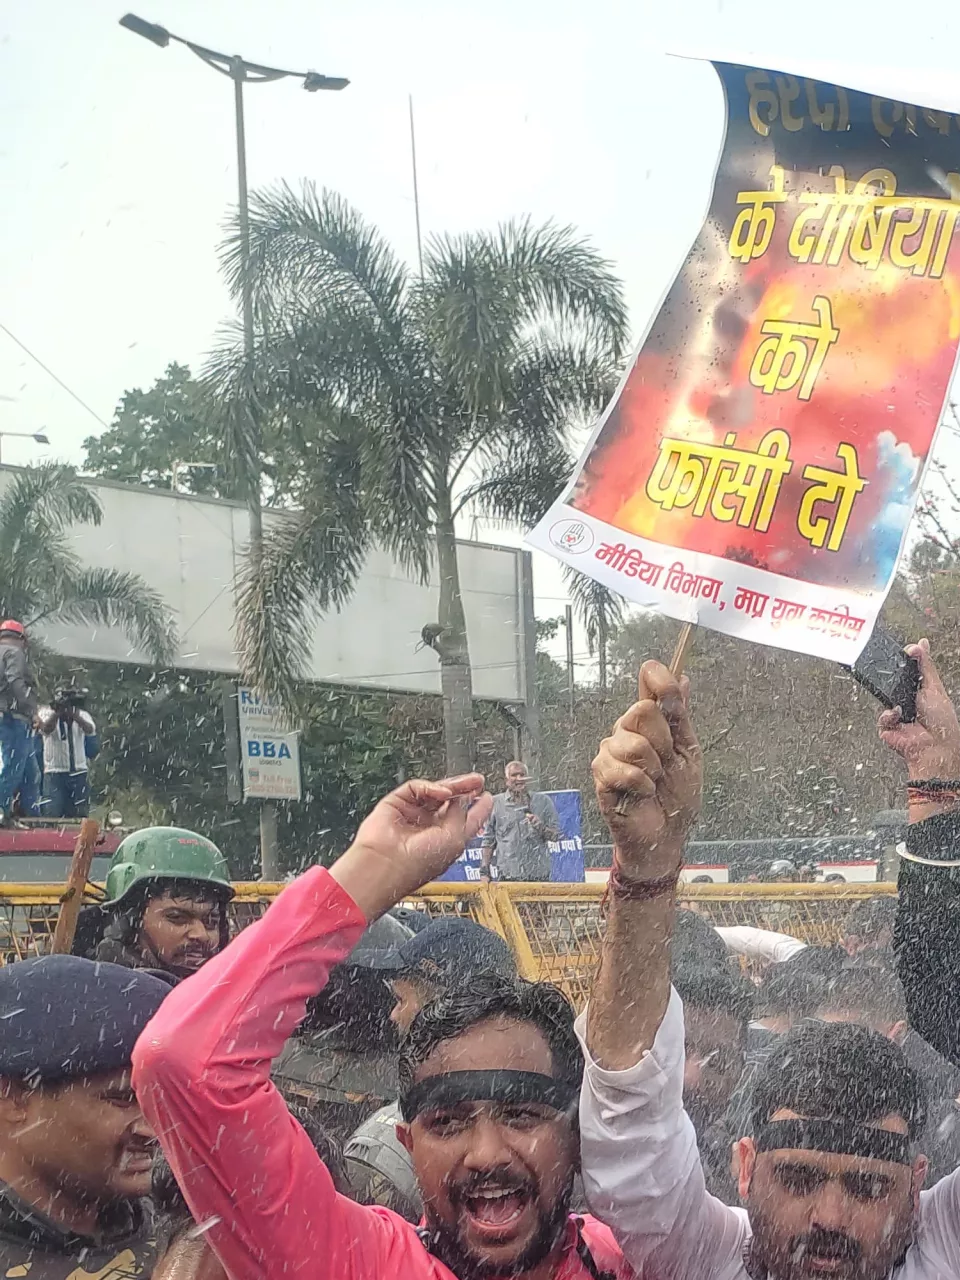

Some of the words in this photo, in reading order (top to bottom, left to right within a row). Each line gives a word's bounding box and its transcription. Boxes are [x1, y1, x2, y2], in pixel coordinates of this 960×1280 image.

[728, 164, 789, 264] के
[749, 295, 840, 400] को
[645, 428, 793, 533] फांसी
[796, 442, 866, 552] दो
[595, 543, 665, 587] मीडिया
[662, 561, 727, 612] विभाग,
[733, 586, 770, 618] मप्र
[770, 597, 807, 630] युवा
[247, 740, 292, 760] BBA
